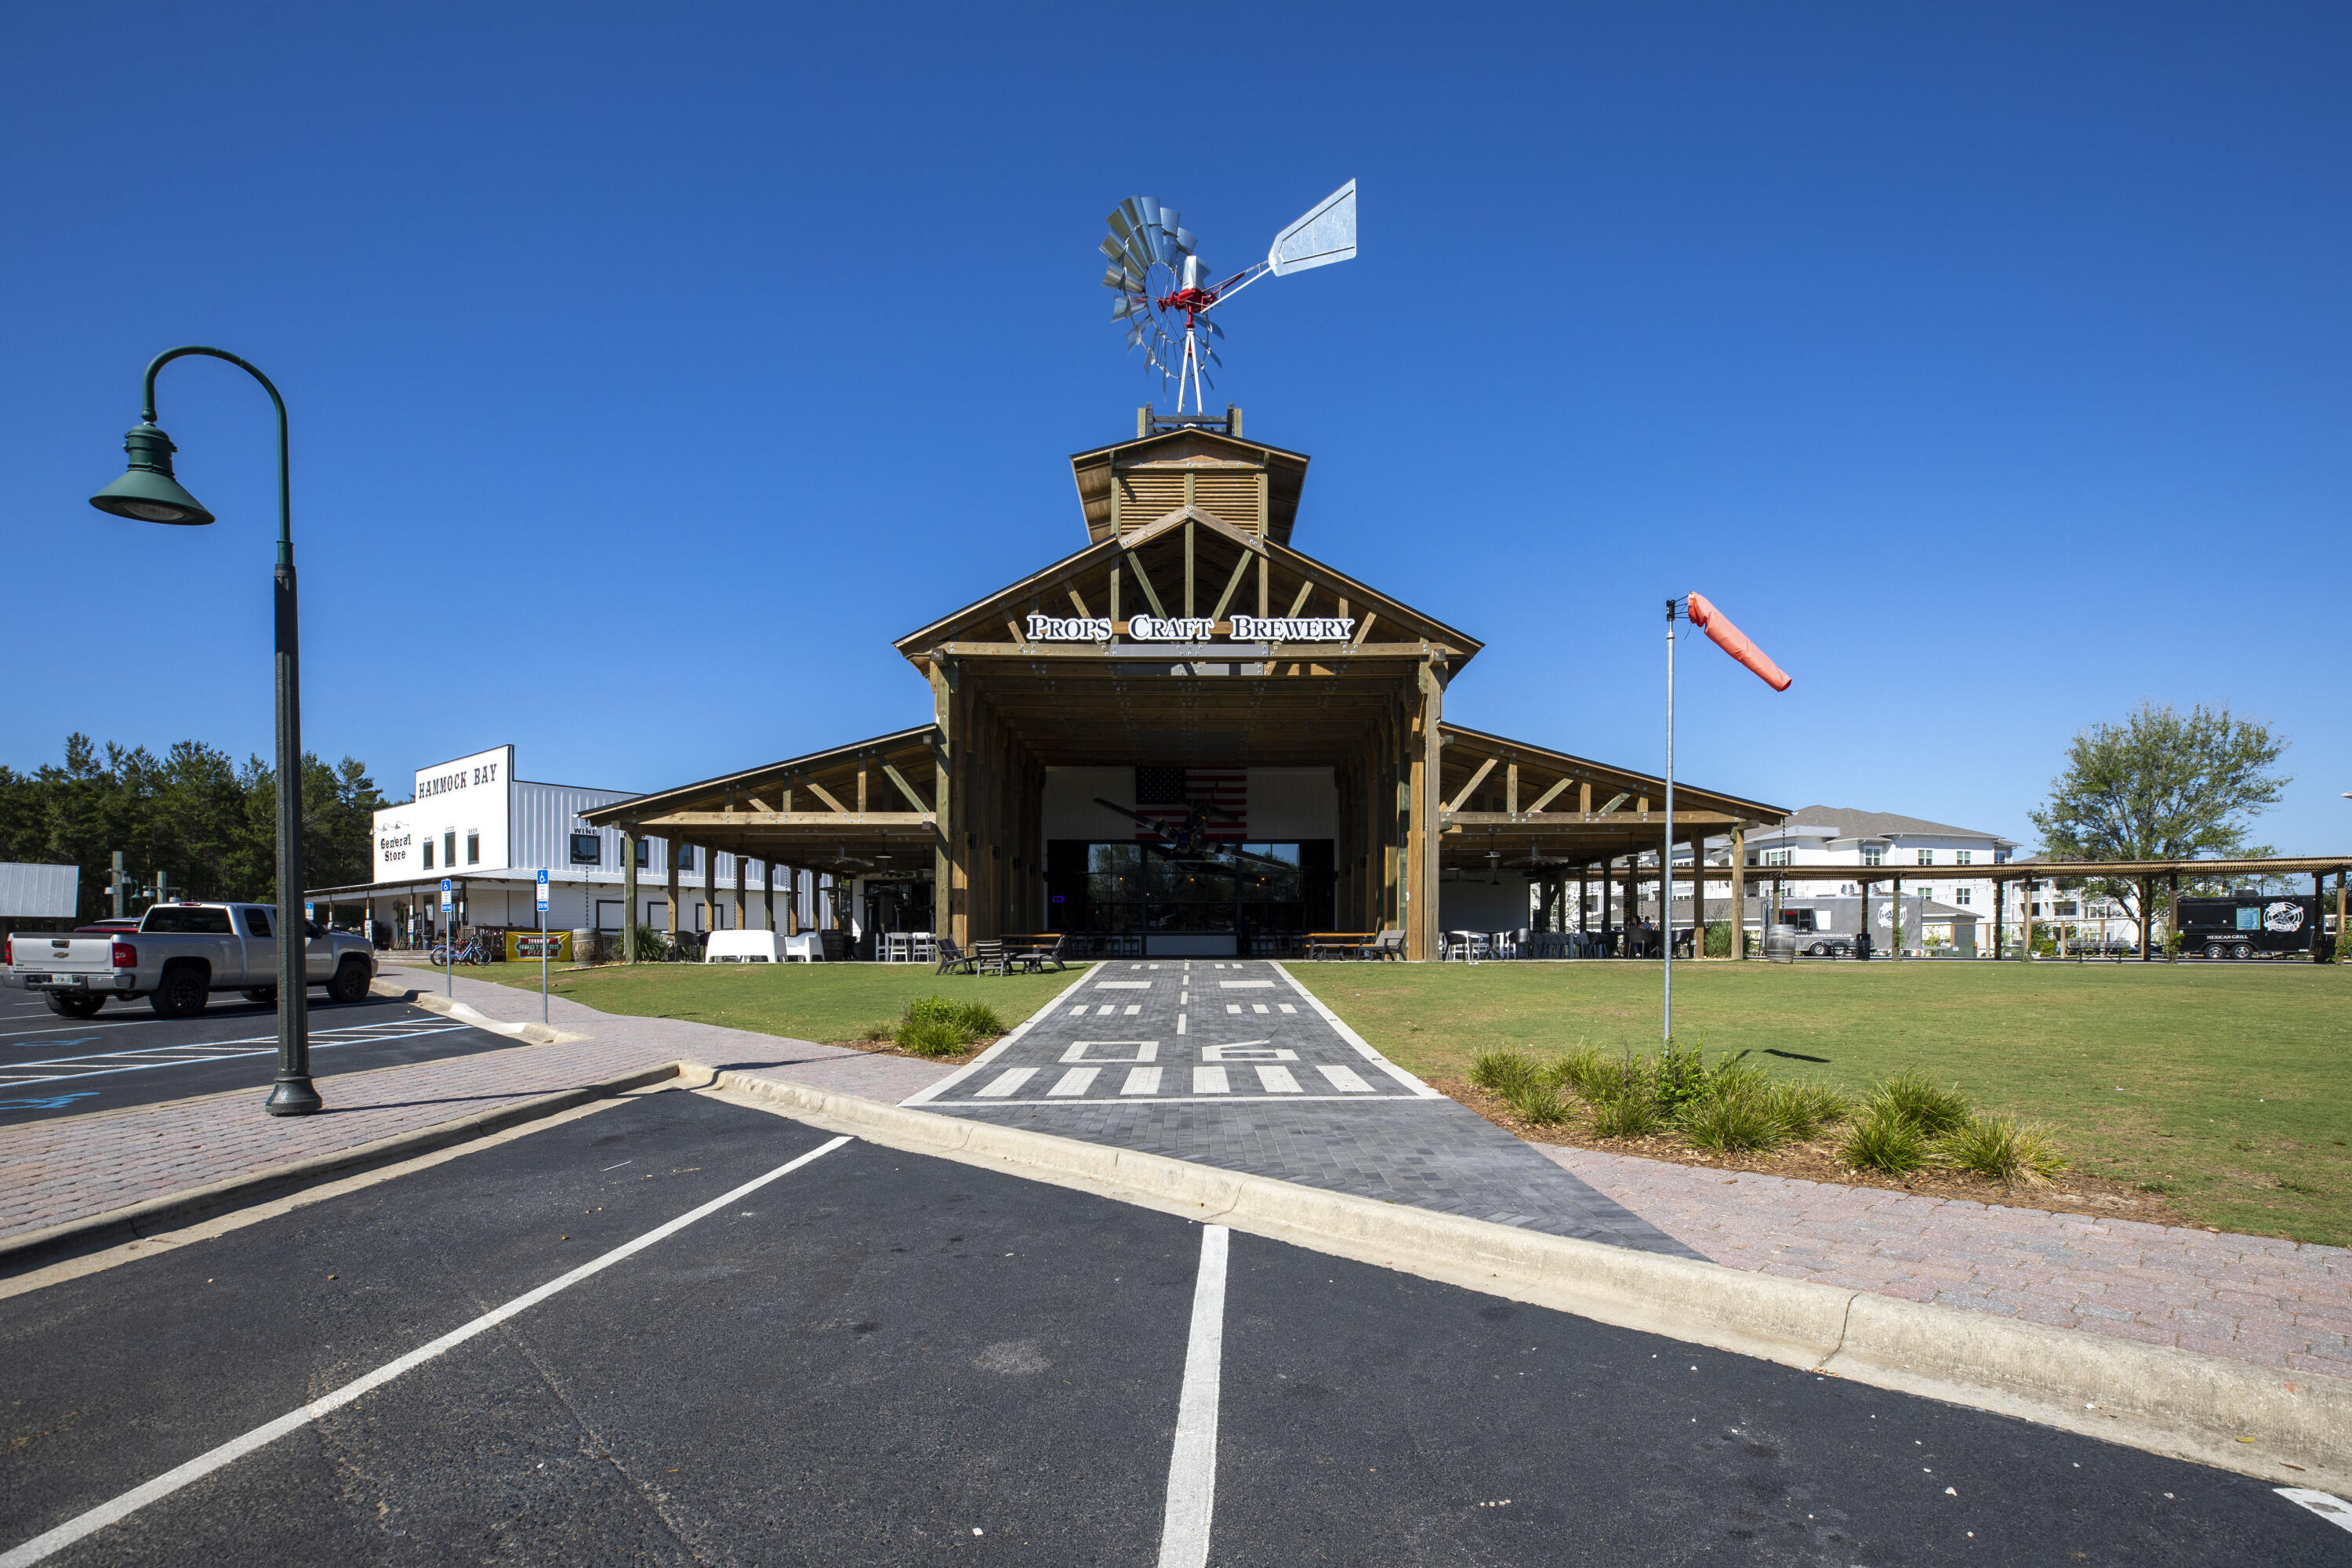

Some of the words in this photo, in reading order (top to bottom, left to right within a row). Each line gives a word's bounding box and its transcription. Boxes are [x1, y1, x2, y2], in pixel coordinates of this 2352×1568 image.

[1027, 615, 1112, 640] PROPS
[1128, 614, 1214, 640] CRAFT
[1229, 615, 1355, 641] BREWERY
[419, 771, 466, 799] HAMMOCK
[474, 764, 497, 786] BAY
[380, 834, 412, 850] General
[384, 851, 406, 862] Store
